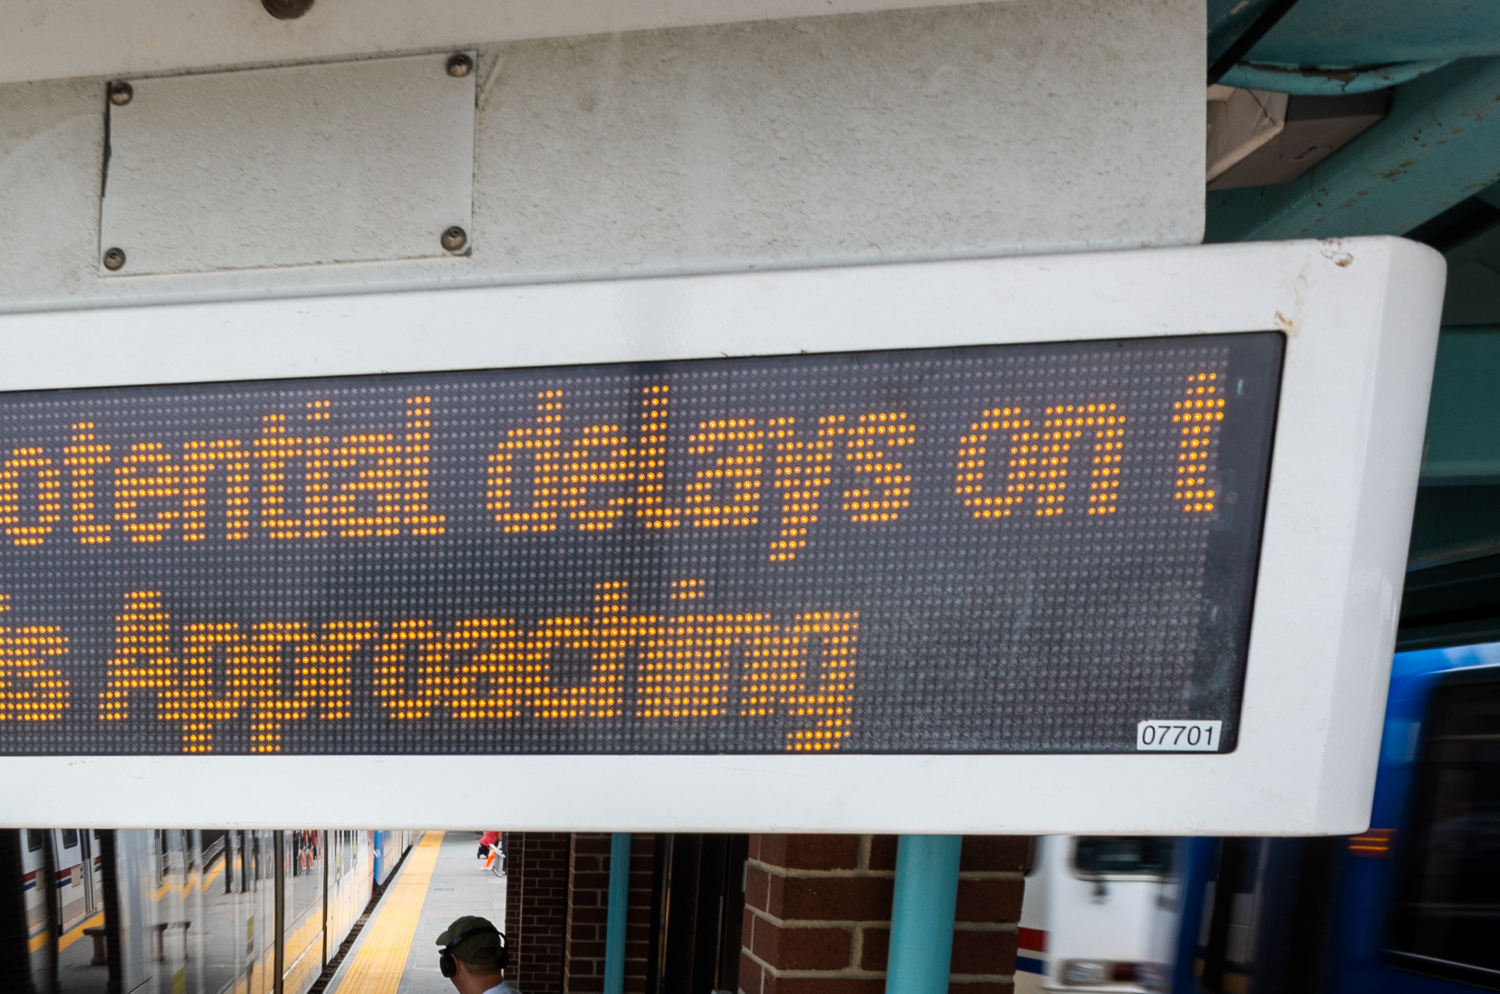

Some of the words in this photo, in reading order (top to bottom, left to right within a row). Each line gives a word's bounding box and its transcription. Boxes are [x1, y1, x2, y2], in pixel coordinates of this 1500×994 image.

[485, 384, 917, 563] delays
[954, 402, 1127, 520] on
[1171, 371, 1227, 513] t
[98, 577, 860, 754] Approaching
[1141, 724, 1214, 747] 07701
